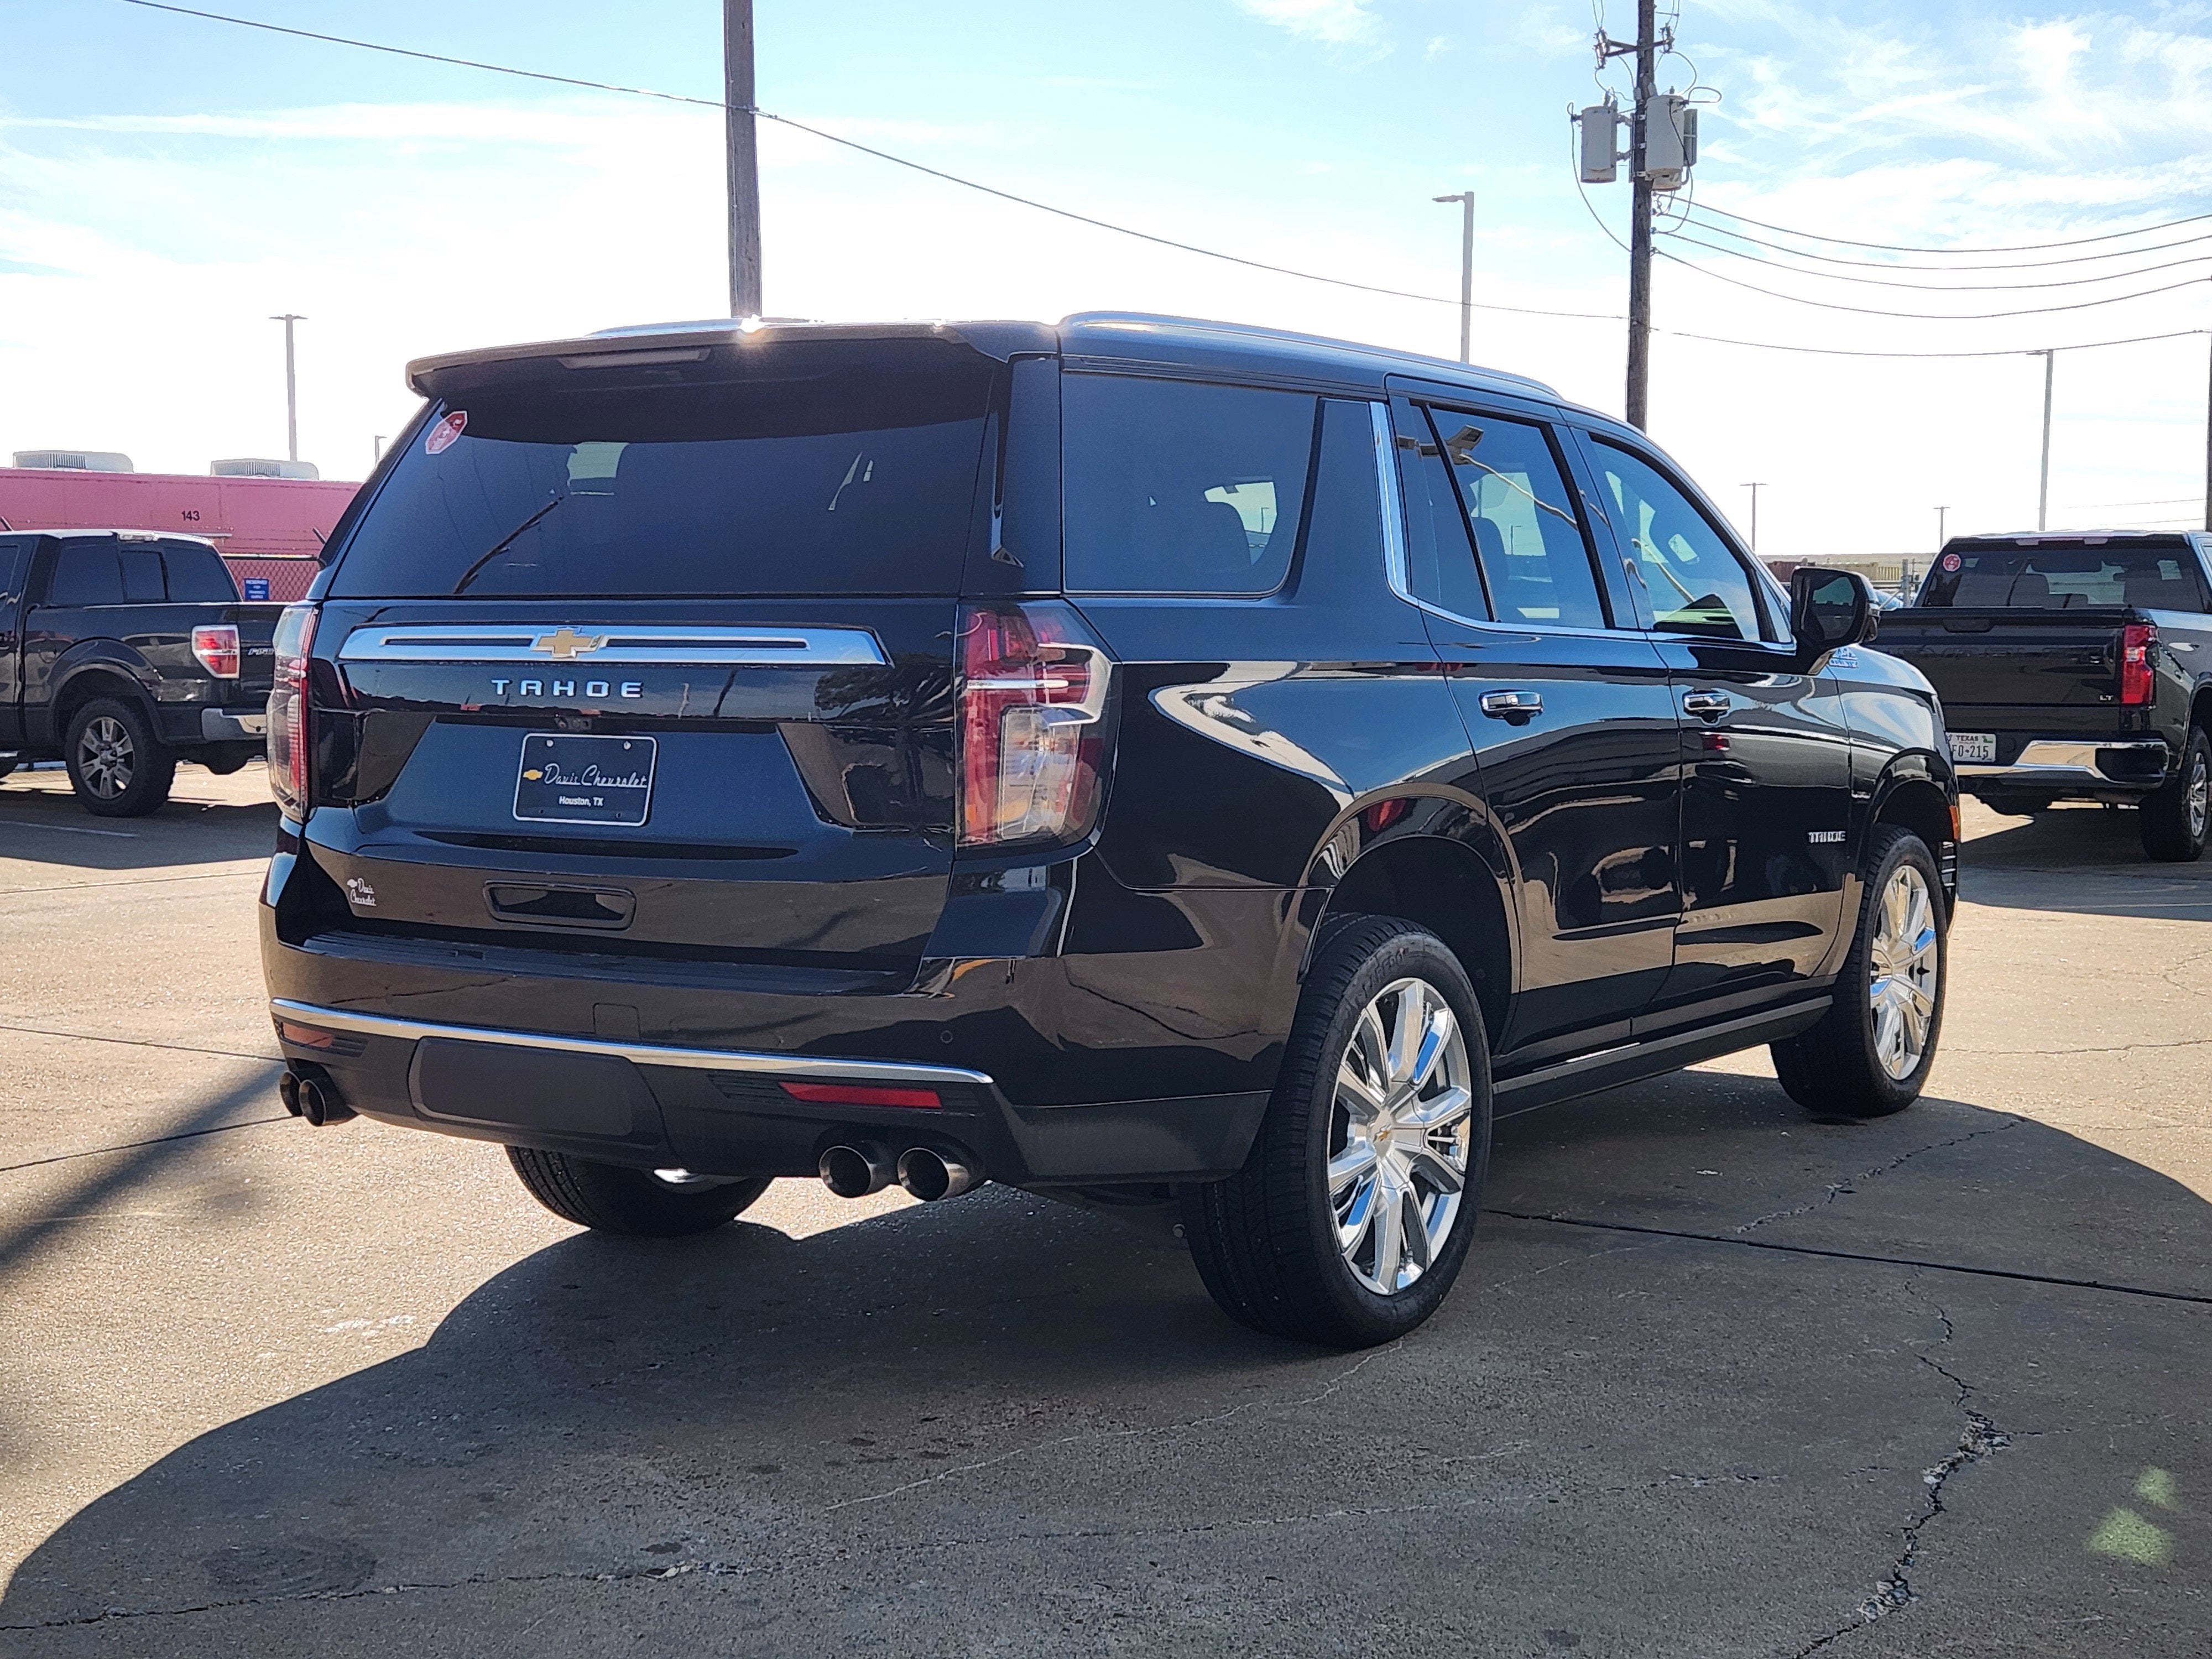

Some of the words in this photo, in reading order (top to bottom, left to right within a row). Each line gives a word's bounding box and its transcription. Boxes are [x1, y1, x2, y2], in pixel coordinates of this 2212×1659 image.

[181, 510, 200, 521] 143
[491, 680, 643, 698] TAHOE
[544, 763, 581, 784] Davis
[582, 765, 648, 788] Chevrolet
[559, 796, 591, 807] Houston,
[593, 796, 604, 807] TX
